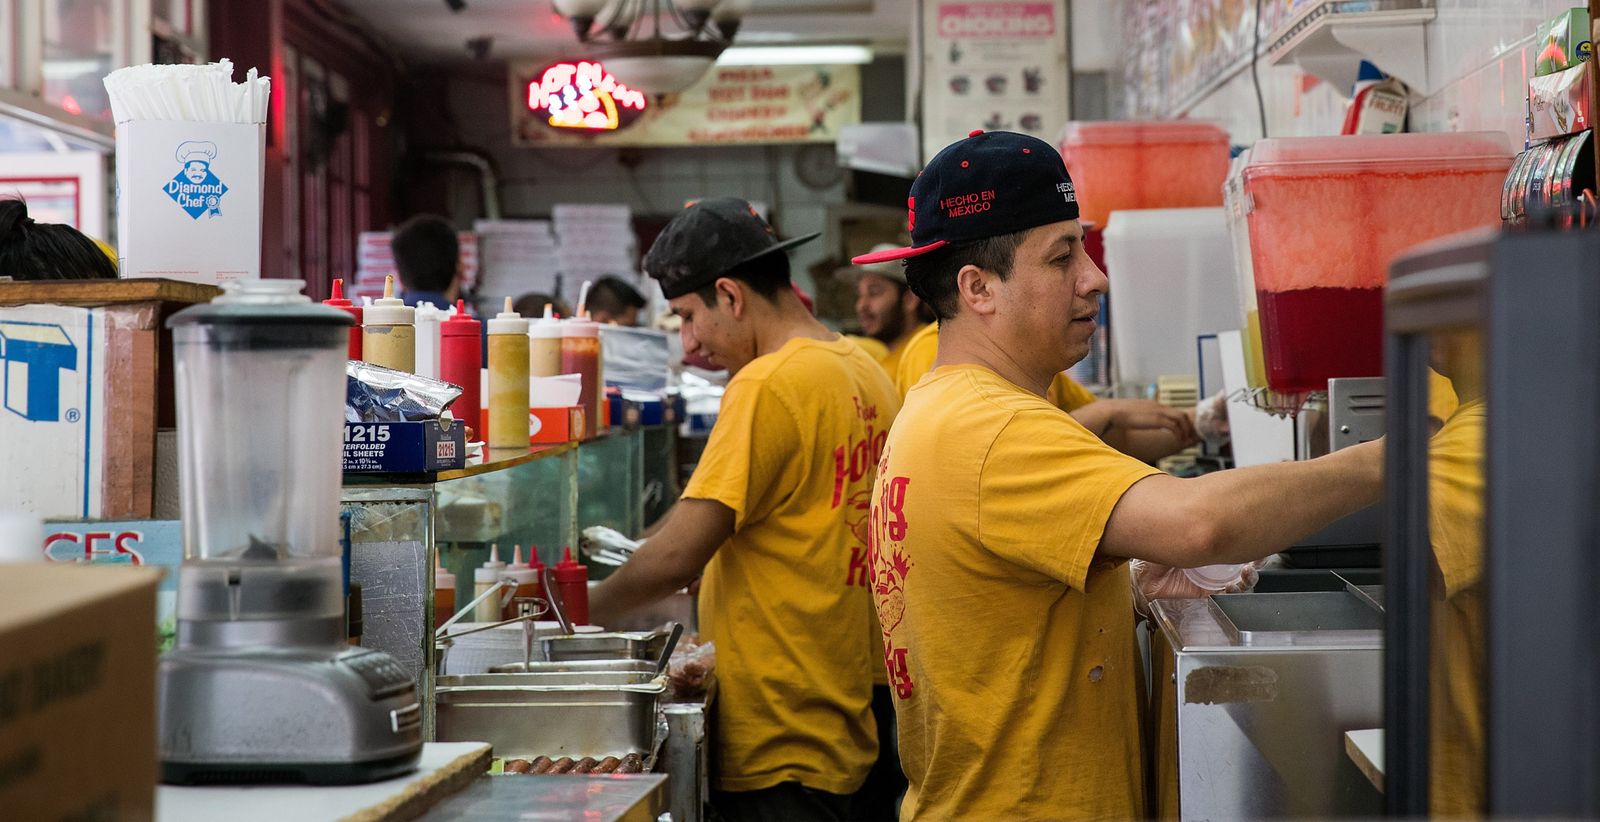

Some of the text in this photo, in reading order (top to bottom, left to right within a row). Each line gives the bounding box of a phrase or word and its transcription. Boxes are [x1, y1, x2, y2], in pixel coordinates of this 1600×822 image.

[169, 179, 223, 195] Diamond
[177, 192, 205, 208] Chef
[940, 189, 996, 210] HECHO EN
[948, 201, 991, 218] MEXICO
[343, 425, 391, 442] 1215
[343, 443, 386, 451] ERFOLDED
[353, 450, 384, 458] SHEETS
[438, 443, 454, 457] 21215
